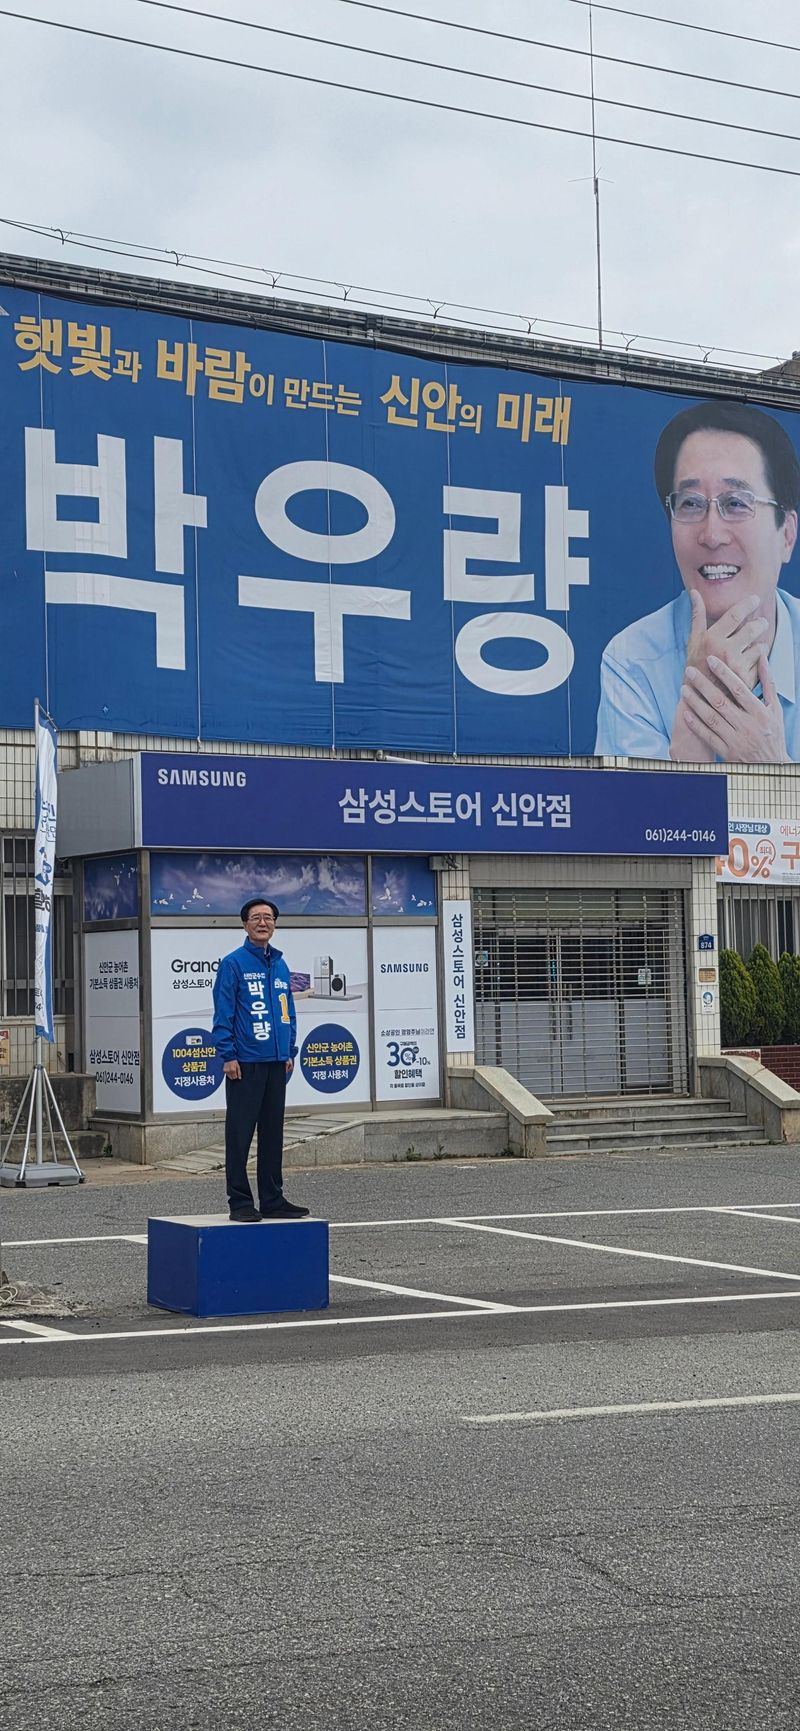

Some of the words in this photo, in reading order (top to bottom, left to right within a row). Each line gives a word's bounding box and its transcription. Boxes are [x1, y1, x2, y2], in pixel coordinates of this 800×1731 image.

[13, 316, 142, 383] 햇빛과
[156, 339, 274, 405] 바람이
[284, 379, 362, 416] 만드는
[380, 374, 482, 434] 신안의
[496, 393, 572, 445] 미래
[24, 426, 590, 696] 박우량
[158, 768, 247, 787] SAMSUNG
[338, 788, 482, 826] 삼성스토어
[491, 793, 572, 828] 신안점
[735, 824, 754, 833] 사장님
[754, 824, 768, 833] 대상
[645, 828, 717, 843] 061)244-0146
[451, 913, 465, 990] 삼성스토어
[99, 961, 113, 974] 신안군
[114, 961, 129, 973] 농어촌
[380, 963, 429, 974] SAMSUNG
[89, 978, 108, 990] 기본소득
[109, 977, 123, 990] 상품권
[124, 977, 139, 989] 사용처
[172, 978, 213, 990] 삼성스토어
[247, 980, 272, 1041] 박우량
[278, 992, 291, 1024] 1
[454, 993, 466, 1039] 신안점
[172, 1047, 217, 1058] 1004섬신안
[306, 1043, 329, 1054] 신안군
[331, 1041, 353, 1053] 농어촌
[89, 1049, 120, 1064] 삼성스토어
[121, 1050, 140, 1066] 신안점
[303, 1056, 333, 1067] 기본소득
[334, 1055, 357, 1066] 상품권
[182, 1061, 207, 1073] 상품권
[174, 1075, 215, 1087] 지정사용처
[312, 1071, 327, 1080] 지정
[328, 1069, 349, 1080] 사용처
